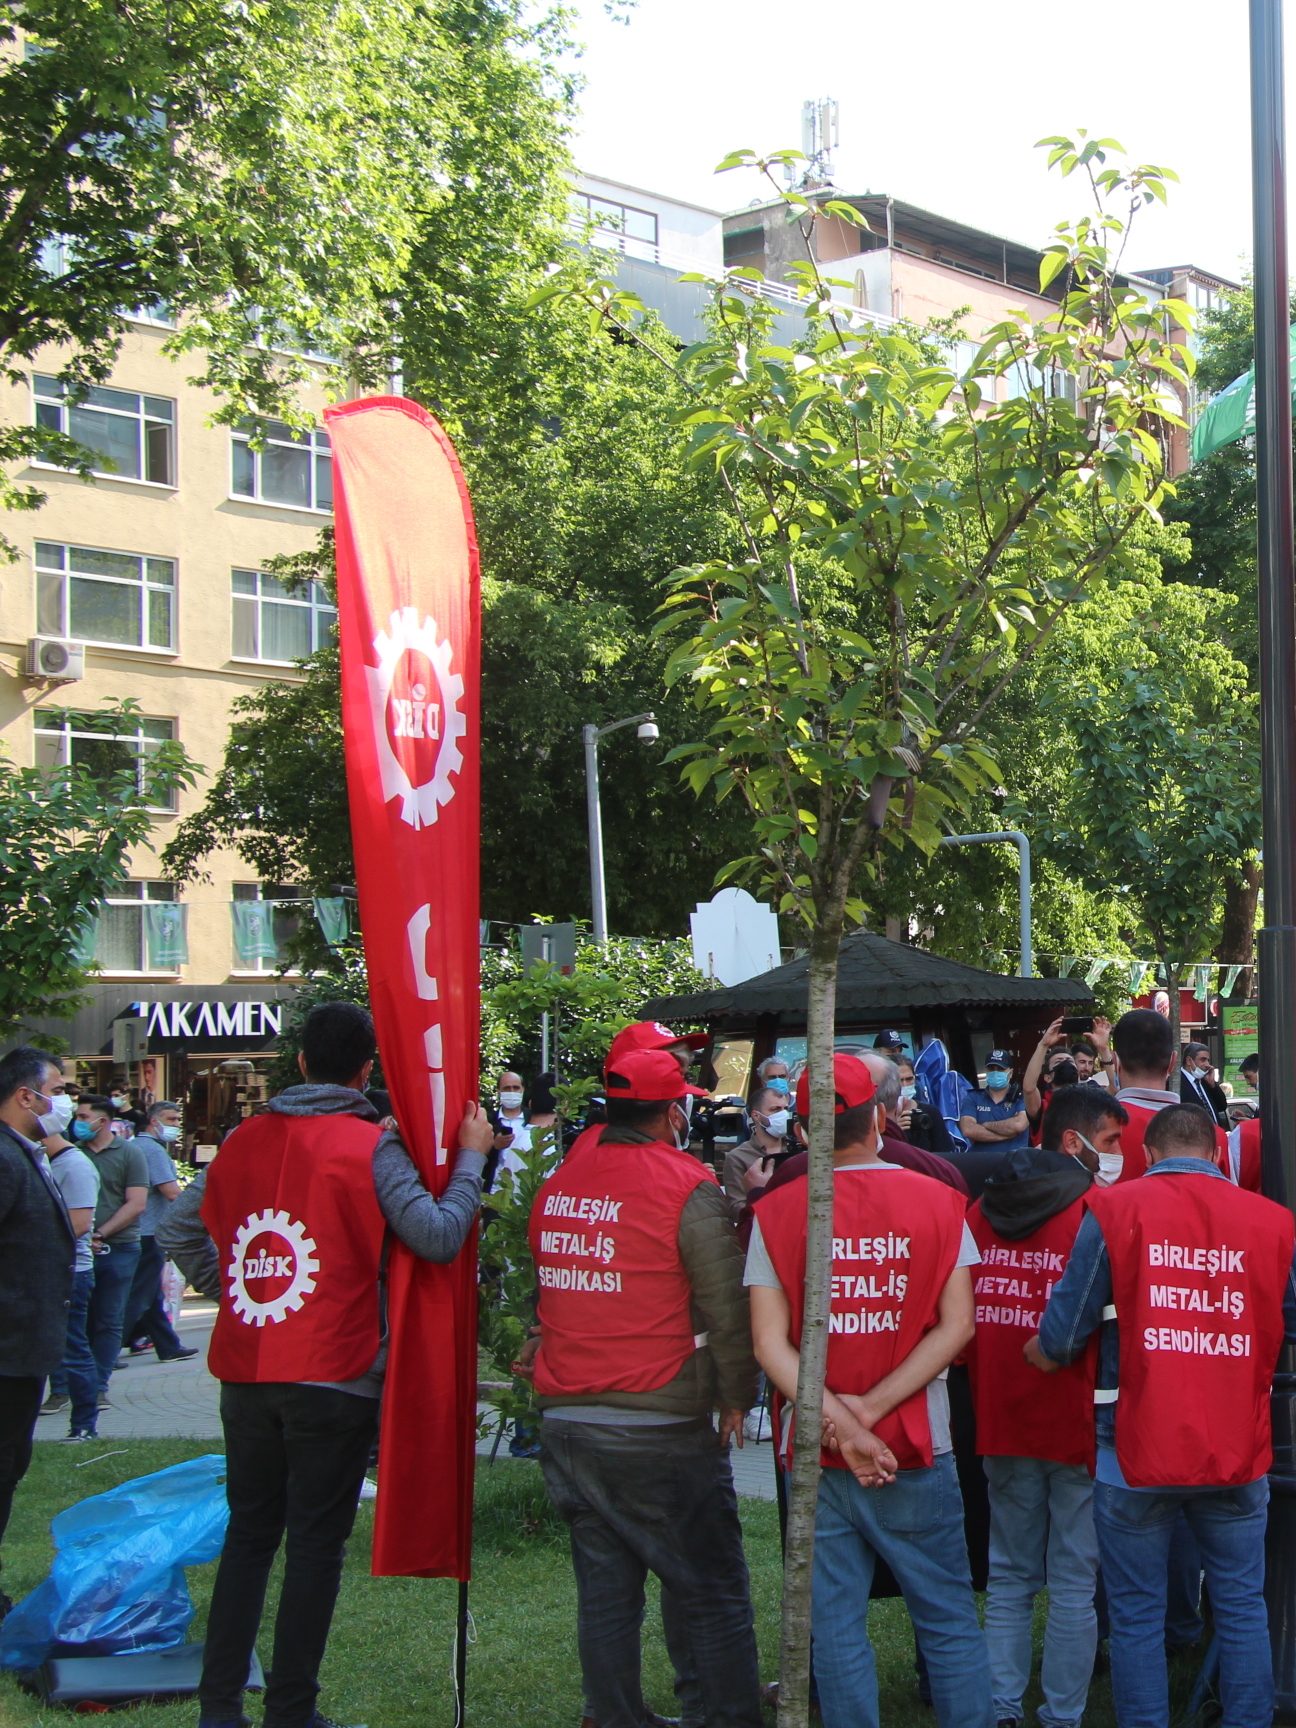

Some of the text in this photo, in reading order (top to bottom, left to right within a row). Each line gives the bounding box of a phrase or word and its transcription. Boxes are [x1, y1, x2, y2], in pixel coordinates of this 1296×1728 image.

[543, 1190, 623, 1226] BİRLEŞİK
[541, 1230, 615, 1264] METAL-İŞ
[832, 1231, 911, 1265] RLEŞİK
[981, 1244, 1065, 1274] BİRLEŞİK
[1148, 1239, 1245, 1278] BİRLEŞİK
[245, 1248, 293, 1279] DİSK
[538, 1264, 622, 1293] SENDİKASI
[831, 1269, 909, 1302] ETAL-İŞ
[975, 1305, 1042, 1329] ENDİK
[1149, 1285, 1245, 1320] METAL-İŞ
[828, 1307, 902, 1334] NDİKAS
[1143, 1325, 1251, 1357] SENDİKASI
